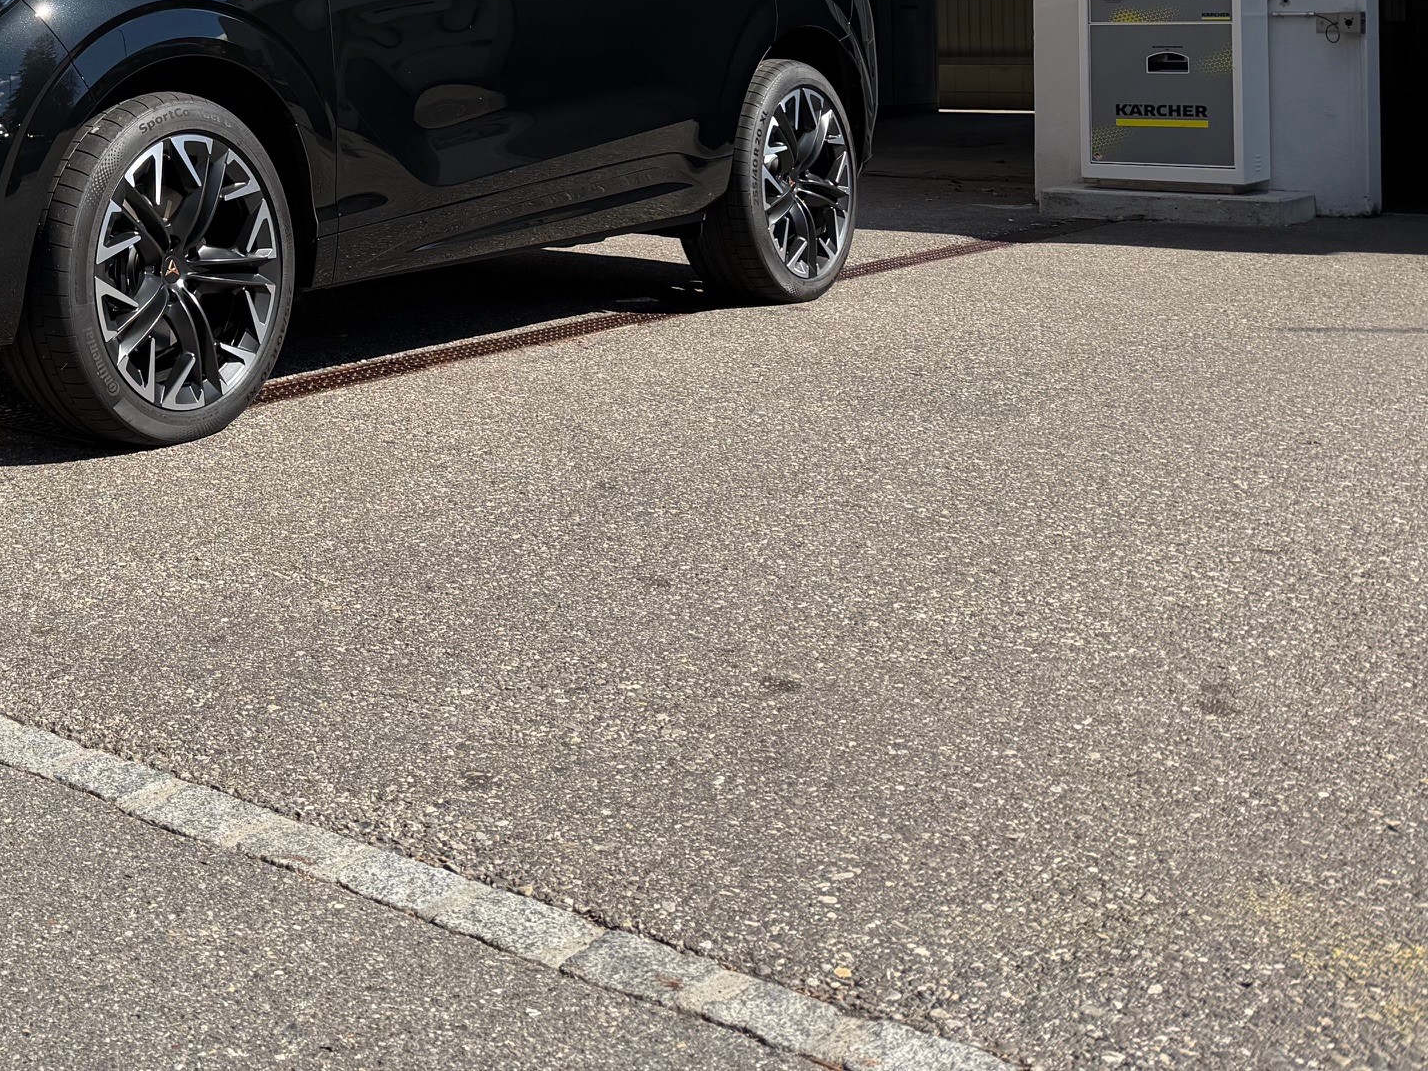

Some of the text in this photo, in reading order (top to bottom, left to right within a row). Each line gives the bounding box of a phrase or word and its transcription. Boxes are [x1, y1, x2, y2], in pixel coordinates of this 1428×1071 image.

[759, 110, 769, 125] XL
[1115, 103, 1209, 118] KÄRCHER
[81, 326, 120, 397] Continental
